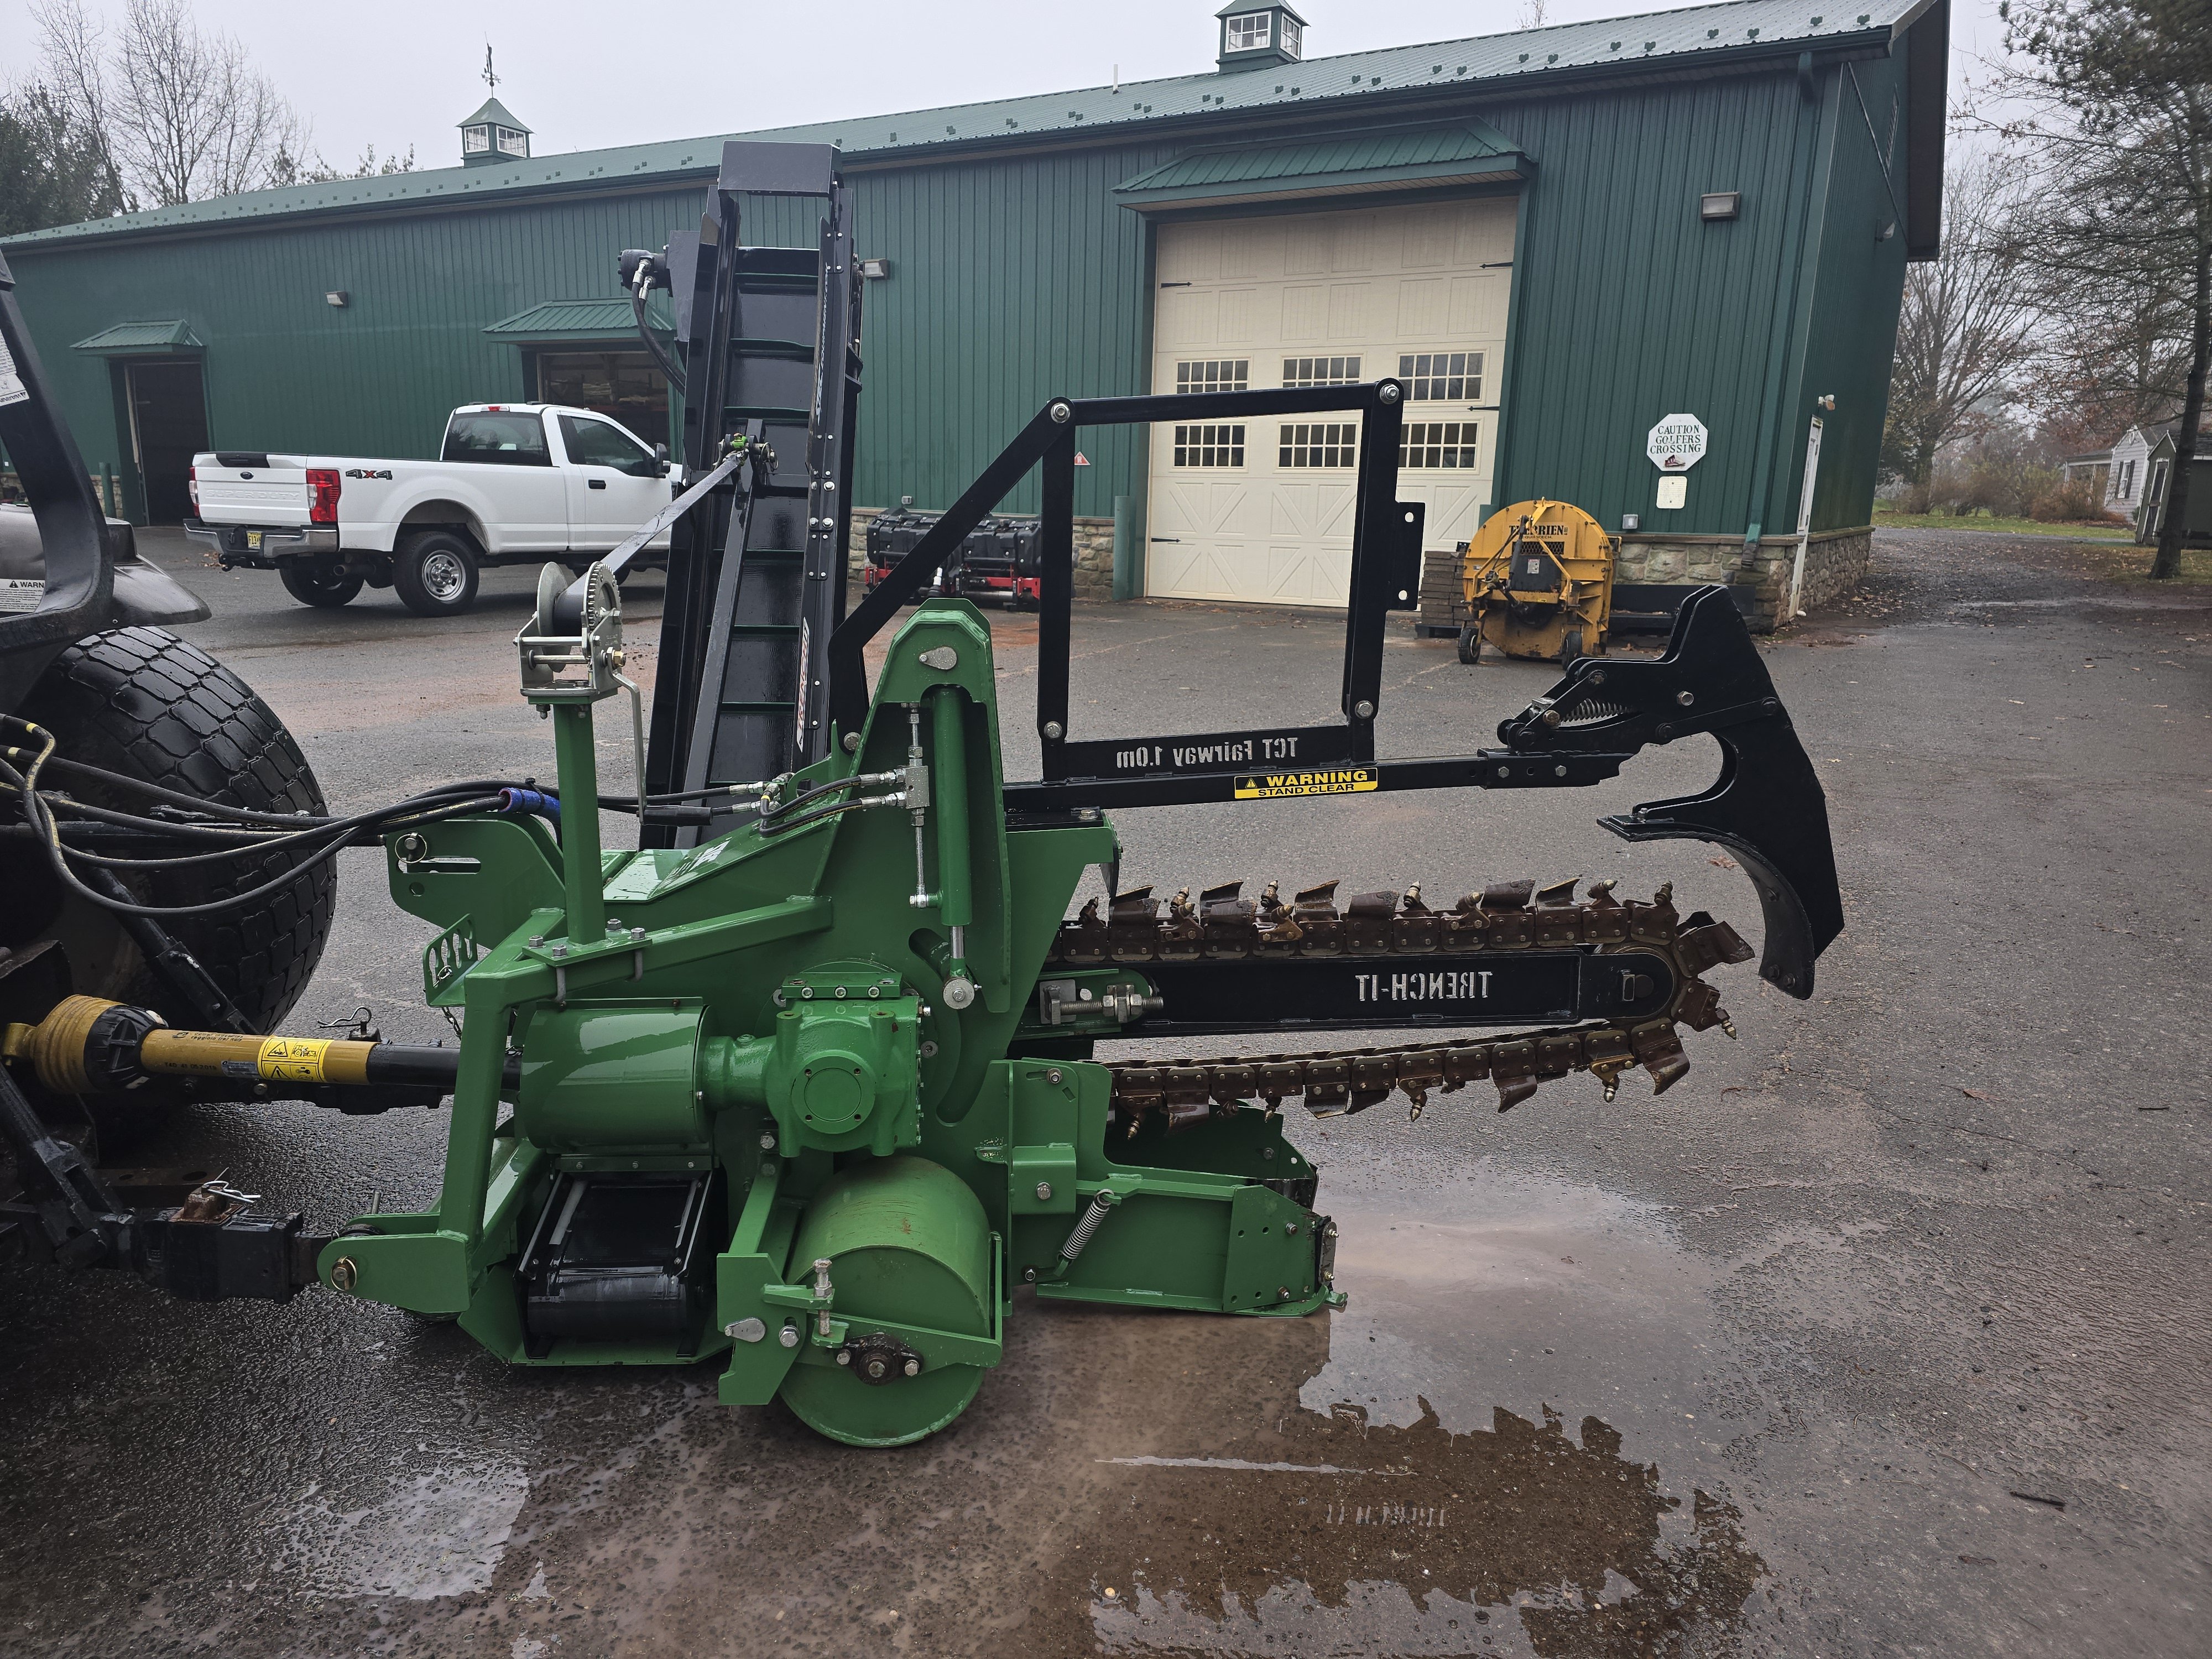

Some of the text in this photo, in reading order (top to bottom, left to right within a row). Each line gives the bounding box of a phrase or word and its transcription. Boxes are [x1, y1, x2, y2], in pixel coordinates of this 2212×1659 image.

[1657, 425, 1699, 435] CAUTION
[1656, 435, 1700, 444] GOLFERS
[1650, 444, 1701, 454] CROSSING
[206, 489, 300, 500] SUPER DUTY
[1266, 770, 1368, 787] WARNING
[1258, 784, 1354, 796] STAND CLEAR
